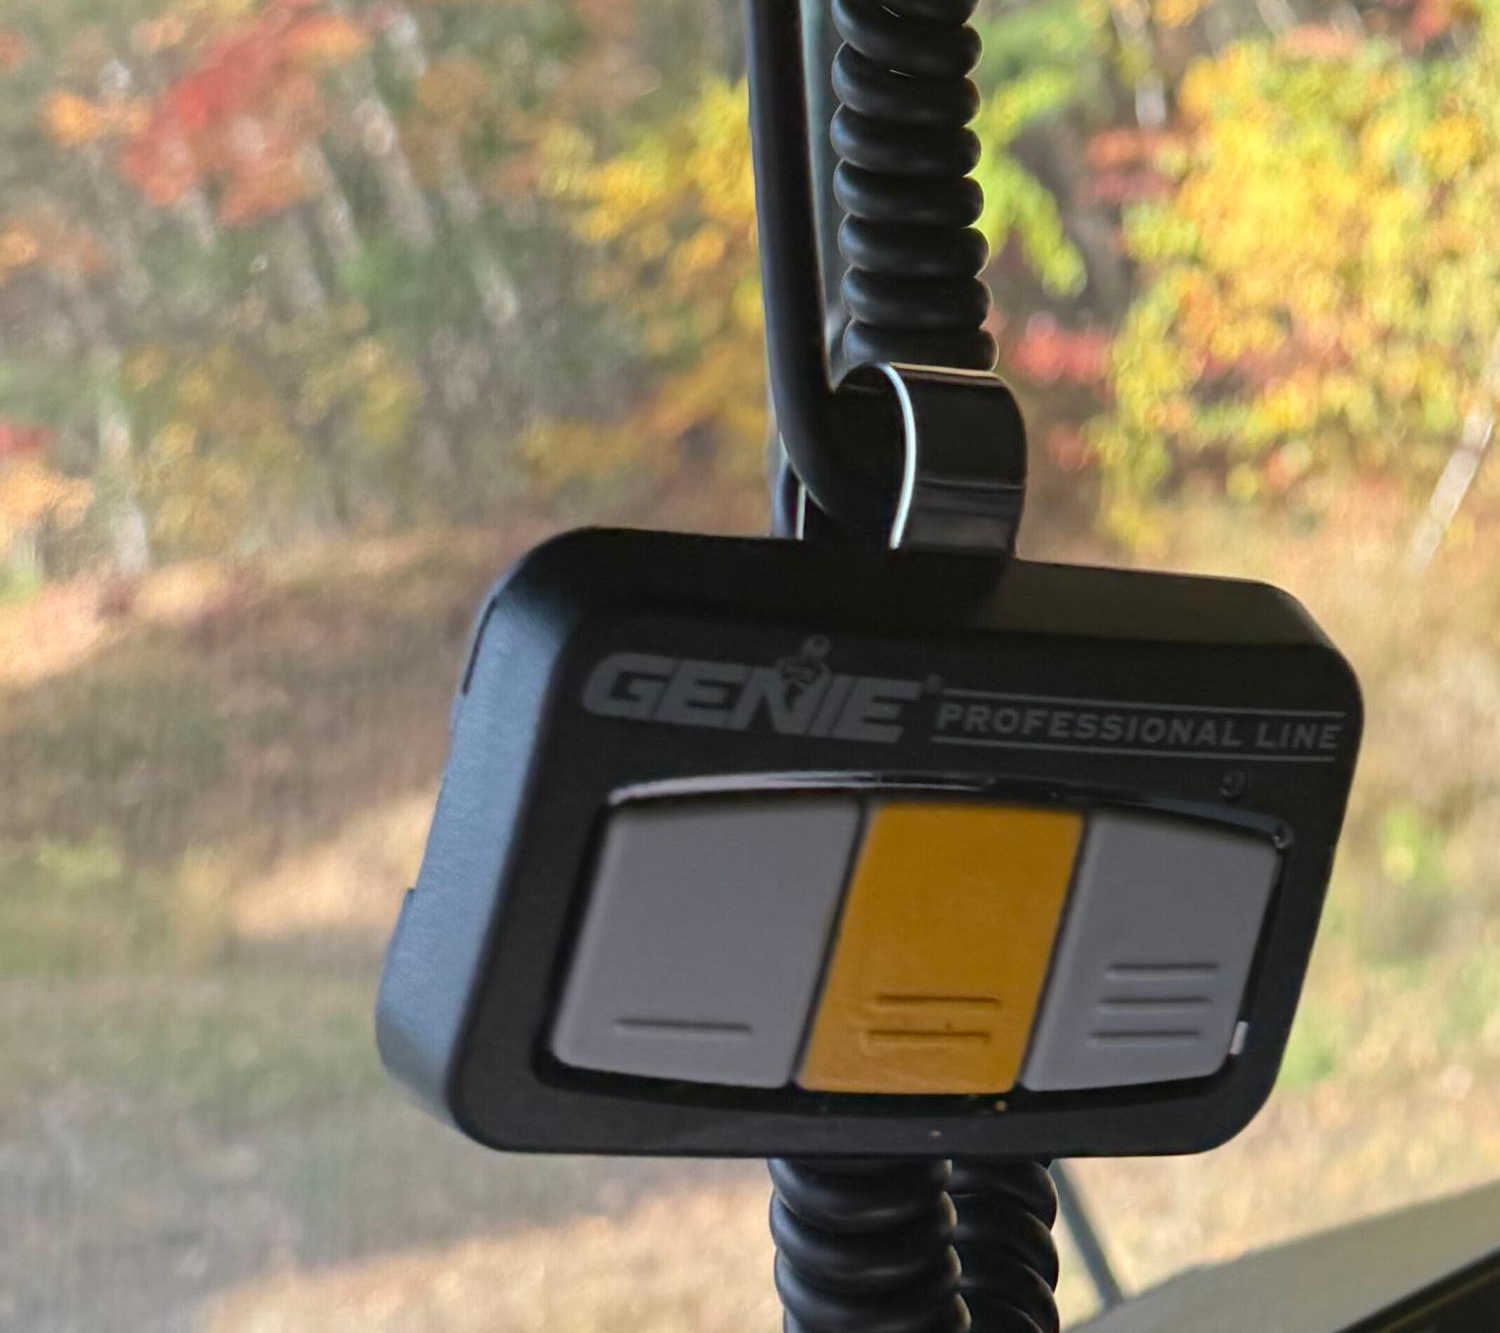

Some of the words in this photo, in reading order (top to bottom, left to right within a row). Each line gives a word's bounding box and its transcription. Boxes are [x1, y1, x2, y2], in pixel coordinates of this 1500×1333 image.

[581, 649, 924, 743] GENIE
[937, 702, 1243, 751] PROFESSIONAL
[1256, 715, 1343, 752] LINE
